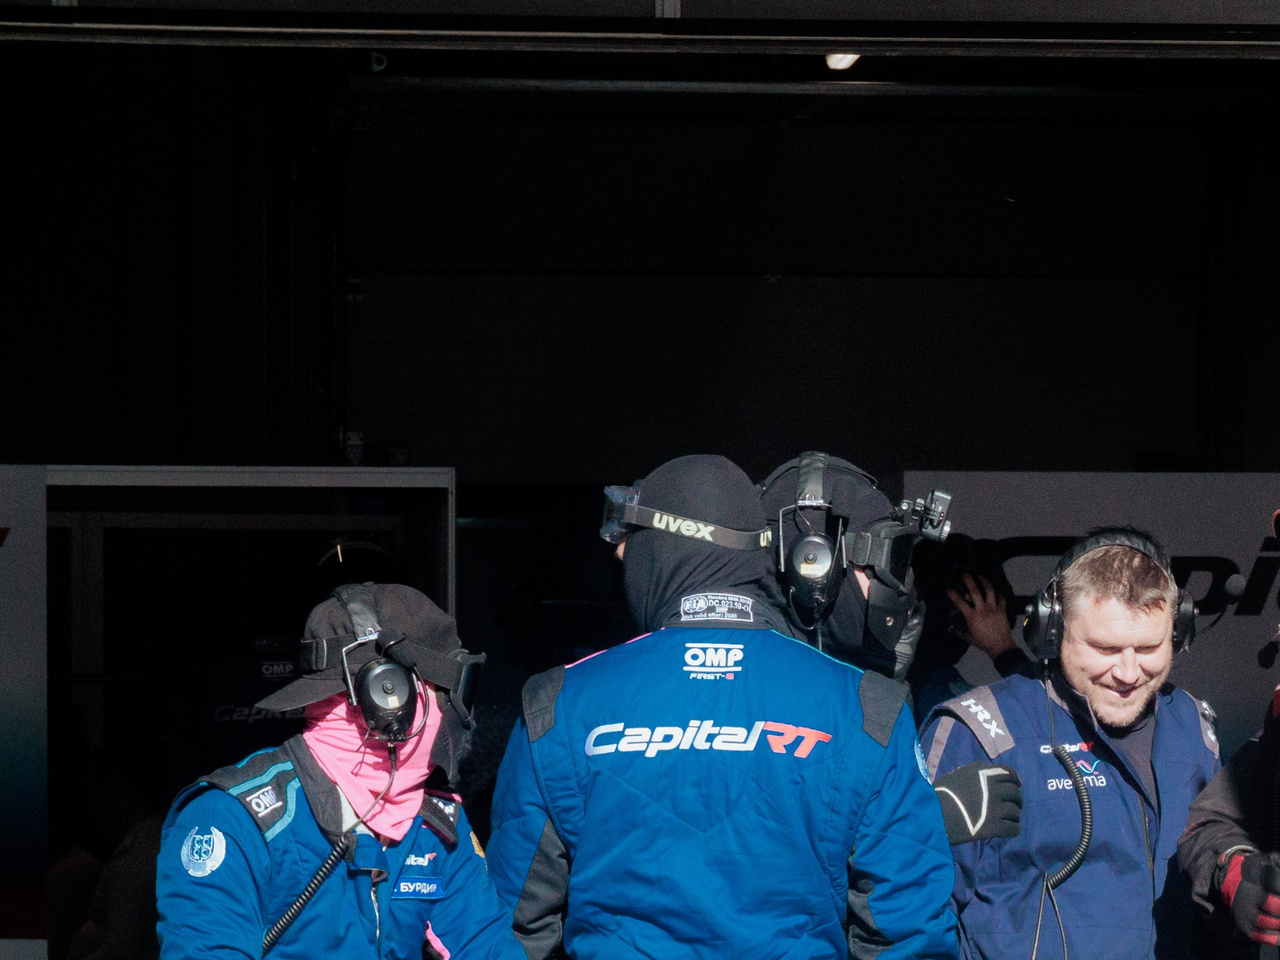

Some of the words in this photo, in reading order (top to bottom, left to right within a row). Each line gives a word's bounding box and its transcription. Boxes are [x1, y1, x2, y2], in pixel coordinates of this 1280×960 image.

[652, 512, 715, 541] uvex
[684, 648, 744, 667] OMP
[960, 698, 1005, 739] HRX
[1047, 775, 1107, 790] avema
